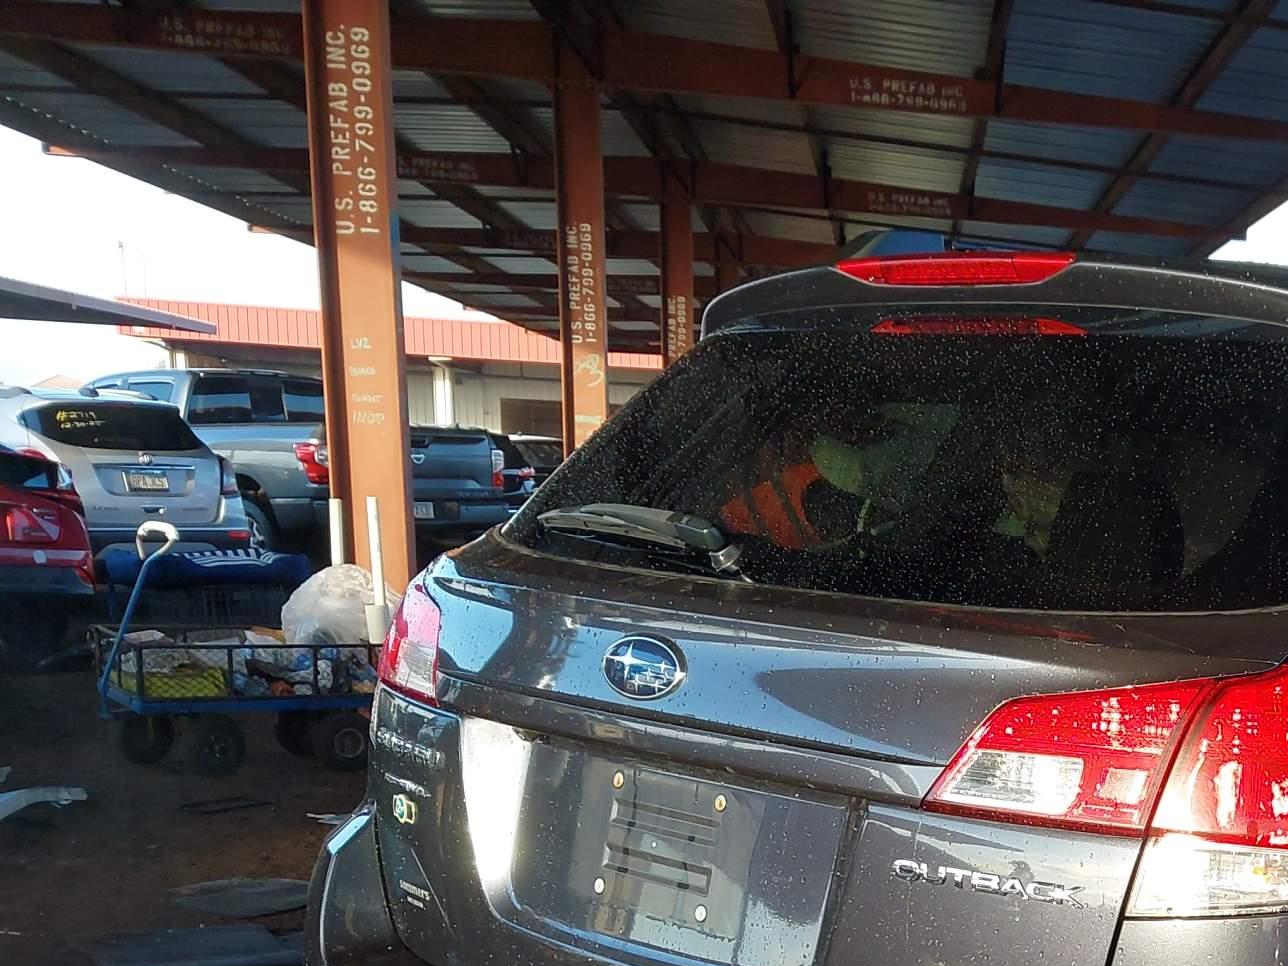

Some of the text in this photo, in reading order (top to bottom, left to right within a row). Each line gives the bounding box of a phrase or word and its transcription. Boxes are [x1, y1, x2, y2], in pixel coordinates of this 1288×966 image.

[325, 24, 355, 234] U.S. PREFAB INC.
[350, 27, 380, 234] 1-866-799-0969
[571, 316, 584, 344] U.S.
[579, 222, 597, 343] 1-866-799-0969
[892, 859, 1088, 910] OUTBACK
